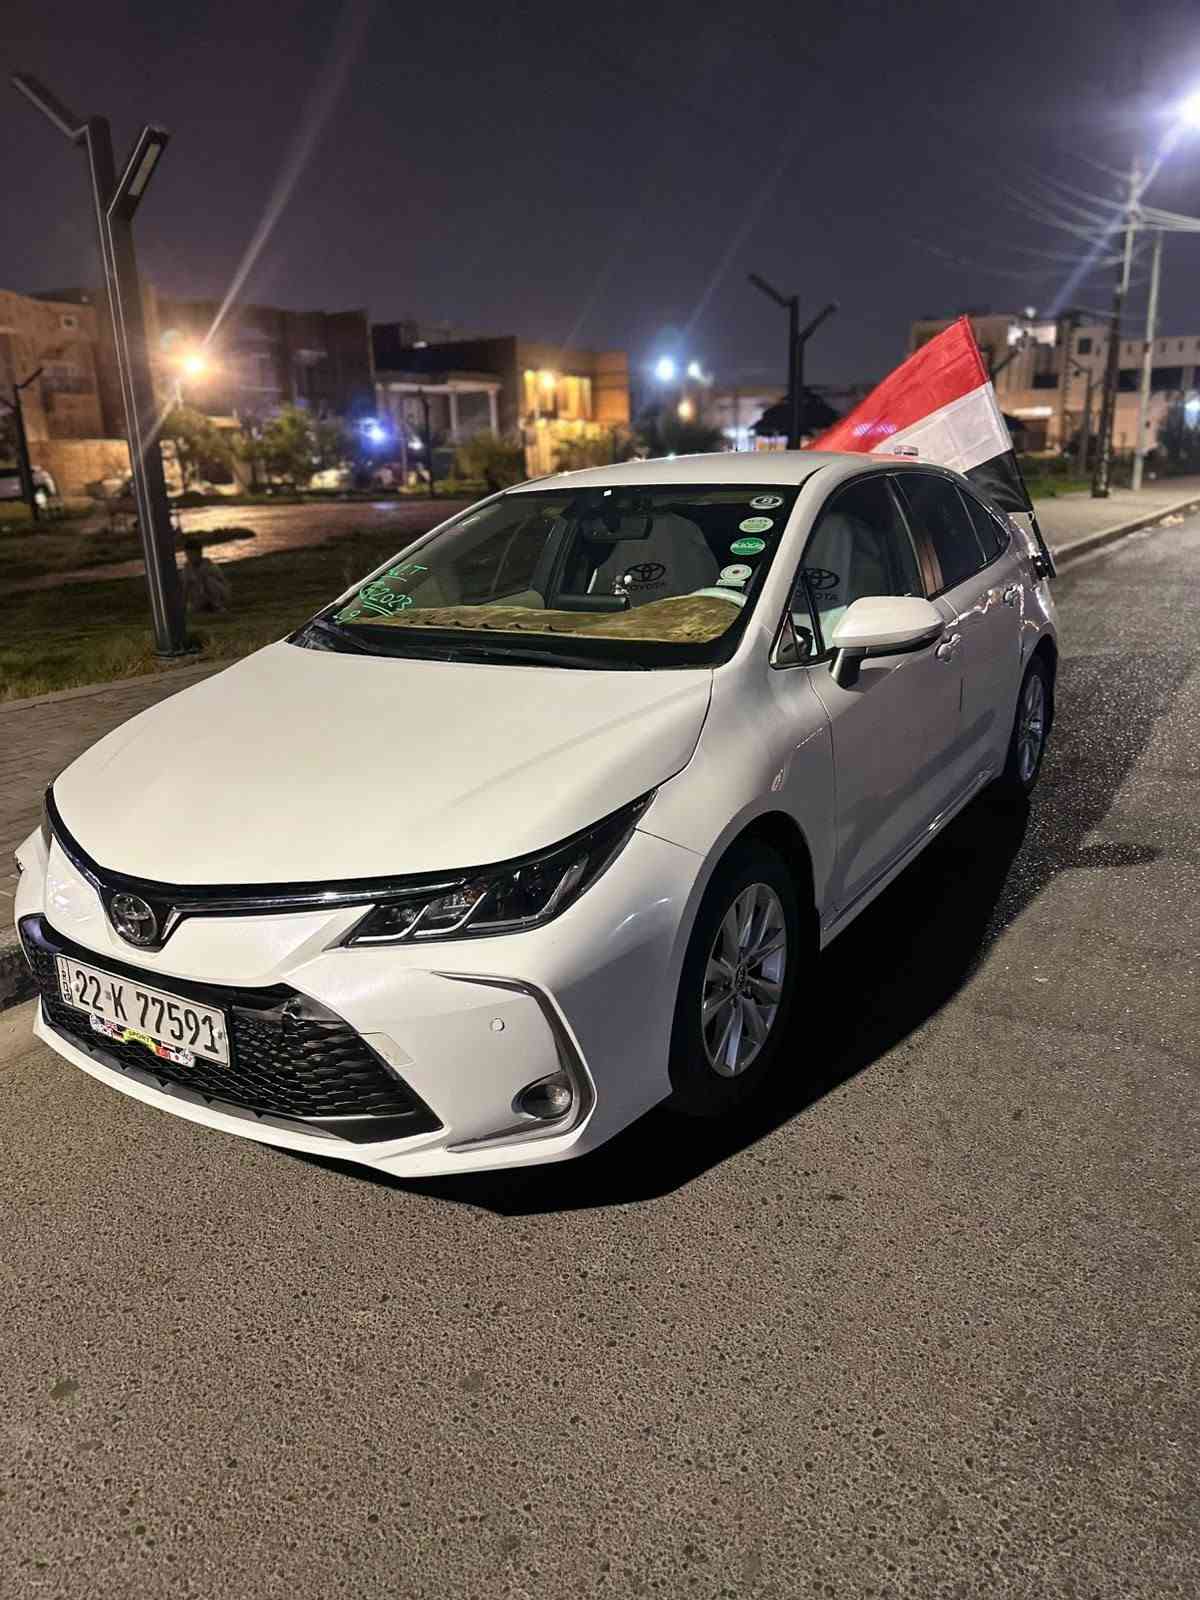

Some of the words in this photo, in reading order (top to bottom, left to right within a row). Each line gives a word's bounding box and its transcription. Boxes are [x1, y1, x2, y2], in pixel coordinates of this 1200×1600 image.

[75, 970, 104, 1011] 22
[110, 982, 128, 1021] K
[136, 990, 219, 1054] 77591
